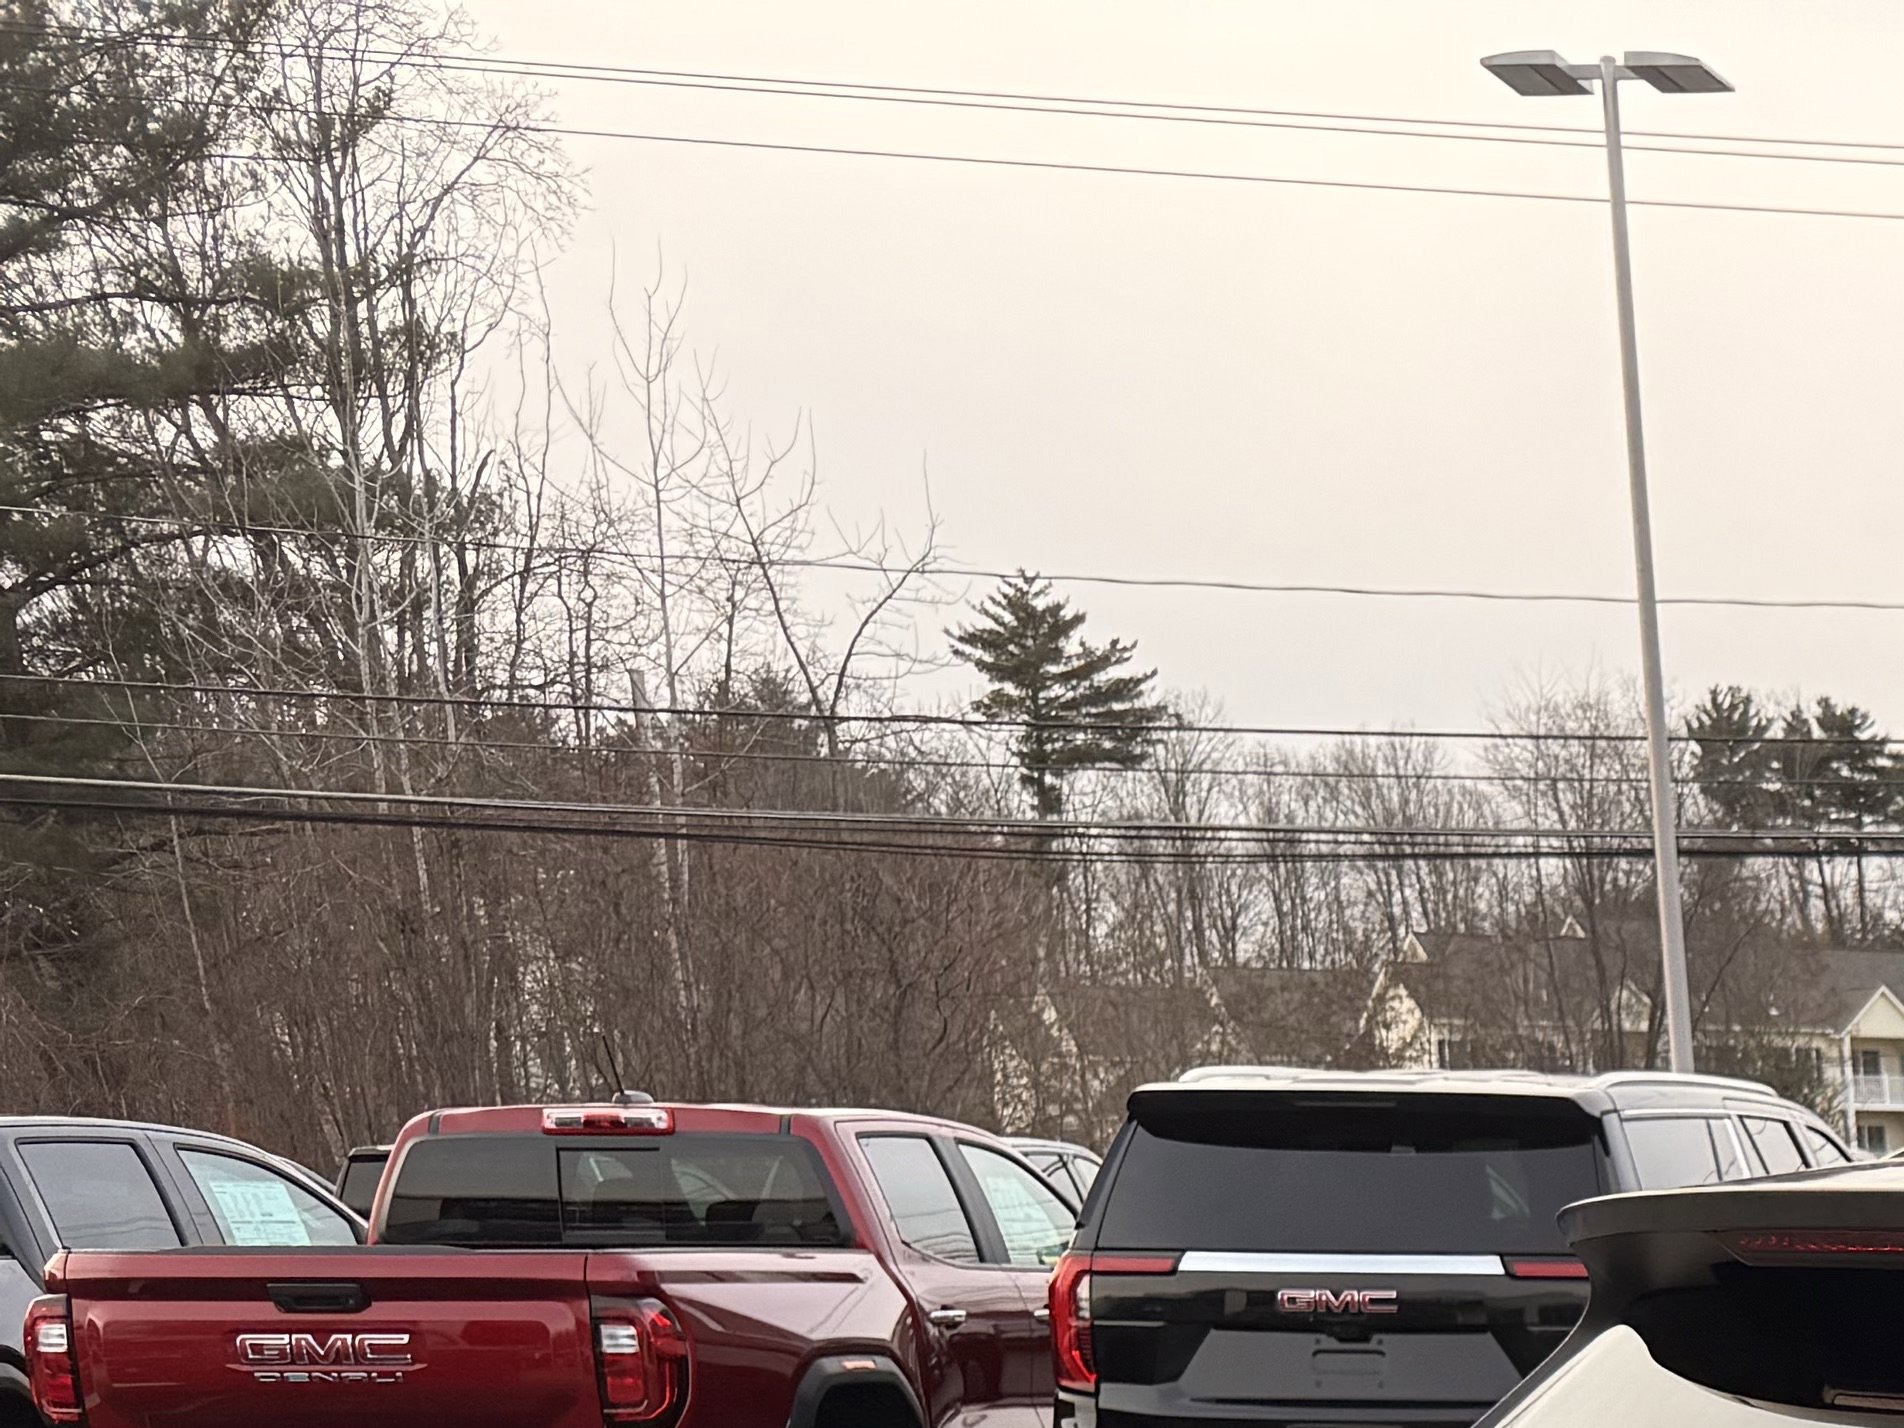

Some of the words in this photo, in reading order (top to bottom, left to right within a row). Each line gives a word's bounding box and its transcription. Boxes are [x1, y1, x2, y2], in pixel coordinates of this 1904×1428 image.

[1277, 1289, 1399, 1313] GMC
[235, 1333, 412, 1364] GMC
[254, 1371, 404, 1383] DENALI
